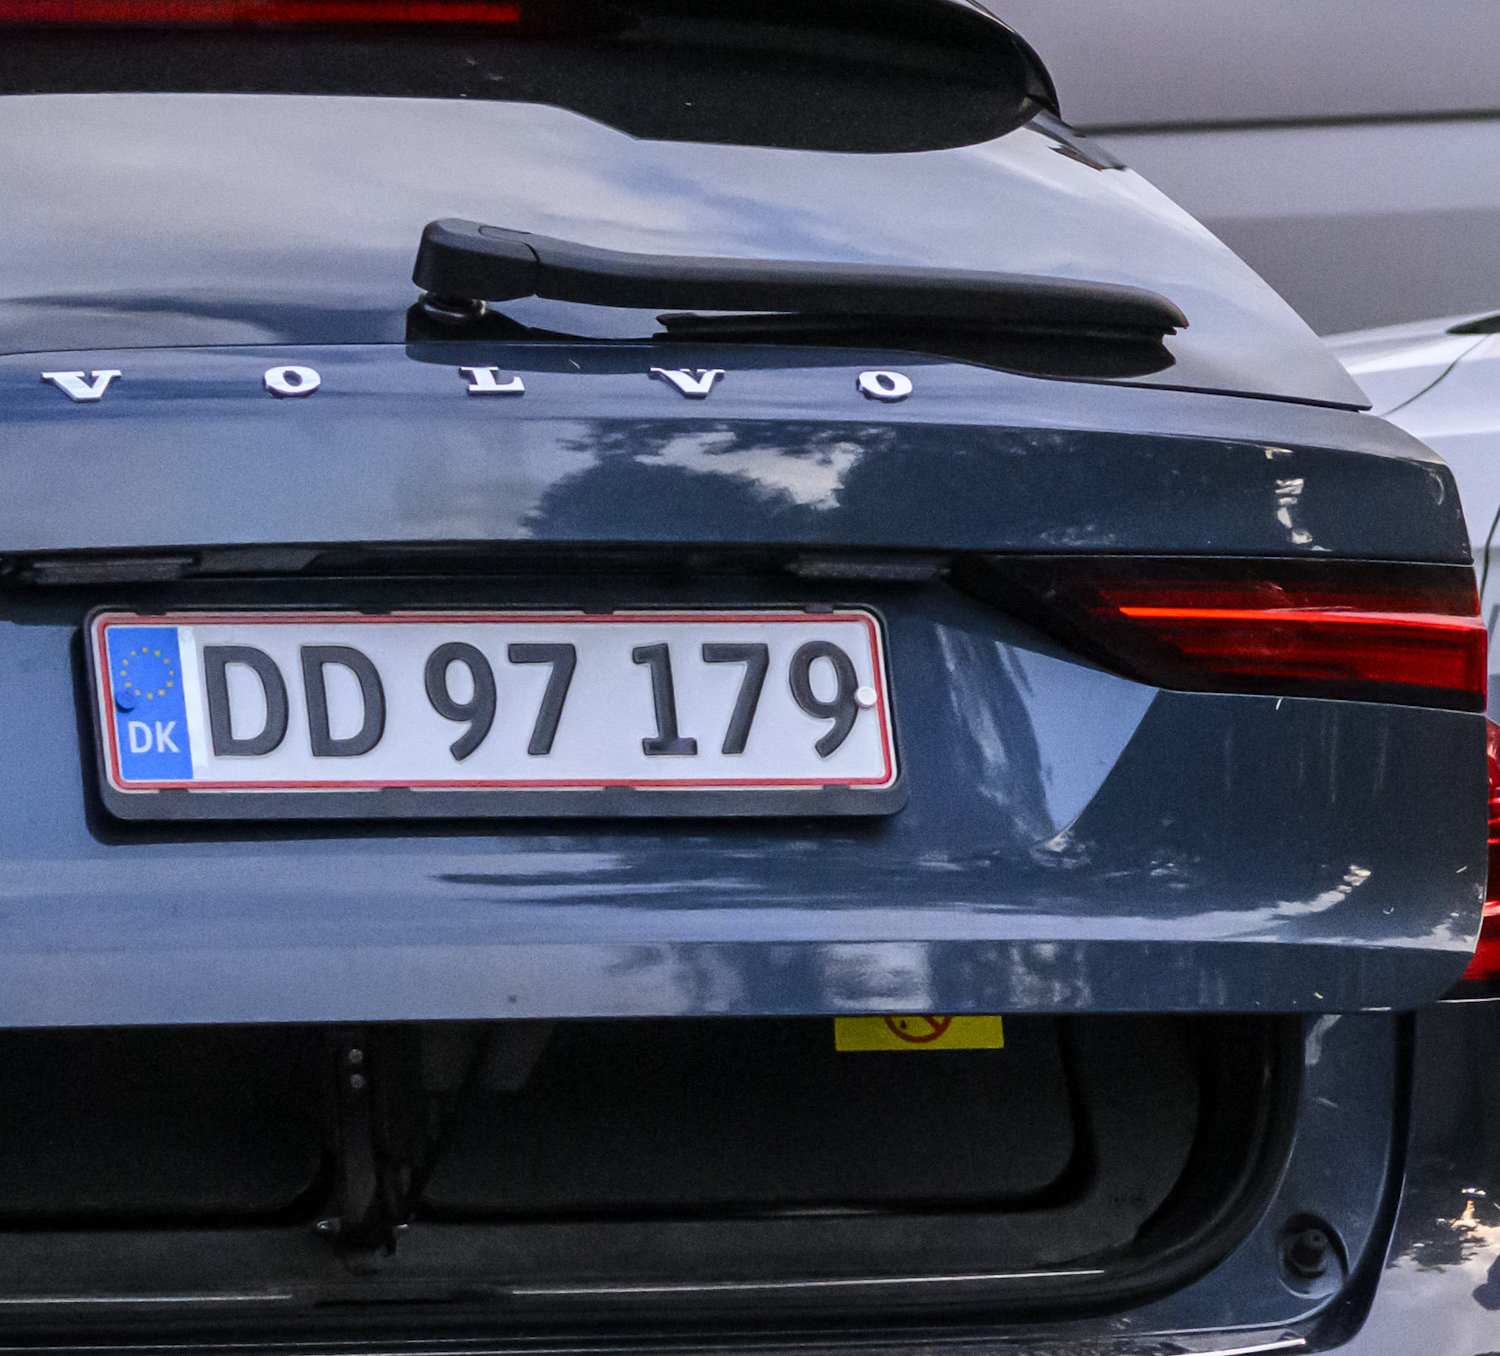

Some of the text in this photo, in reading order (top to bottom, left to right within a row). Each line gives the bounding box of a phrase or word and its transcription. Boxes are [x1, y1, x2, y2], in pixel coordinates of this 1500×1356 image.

[42, 365, 914, 402] VOLVO
[201, 638, 860, 761] DD 97 179
[128, 718, 182, 756] DK
